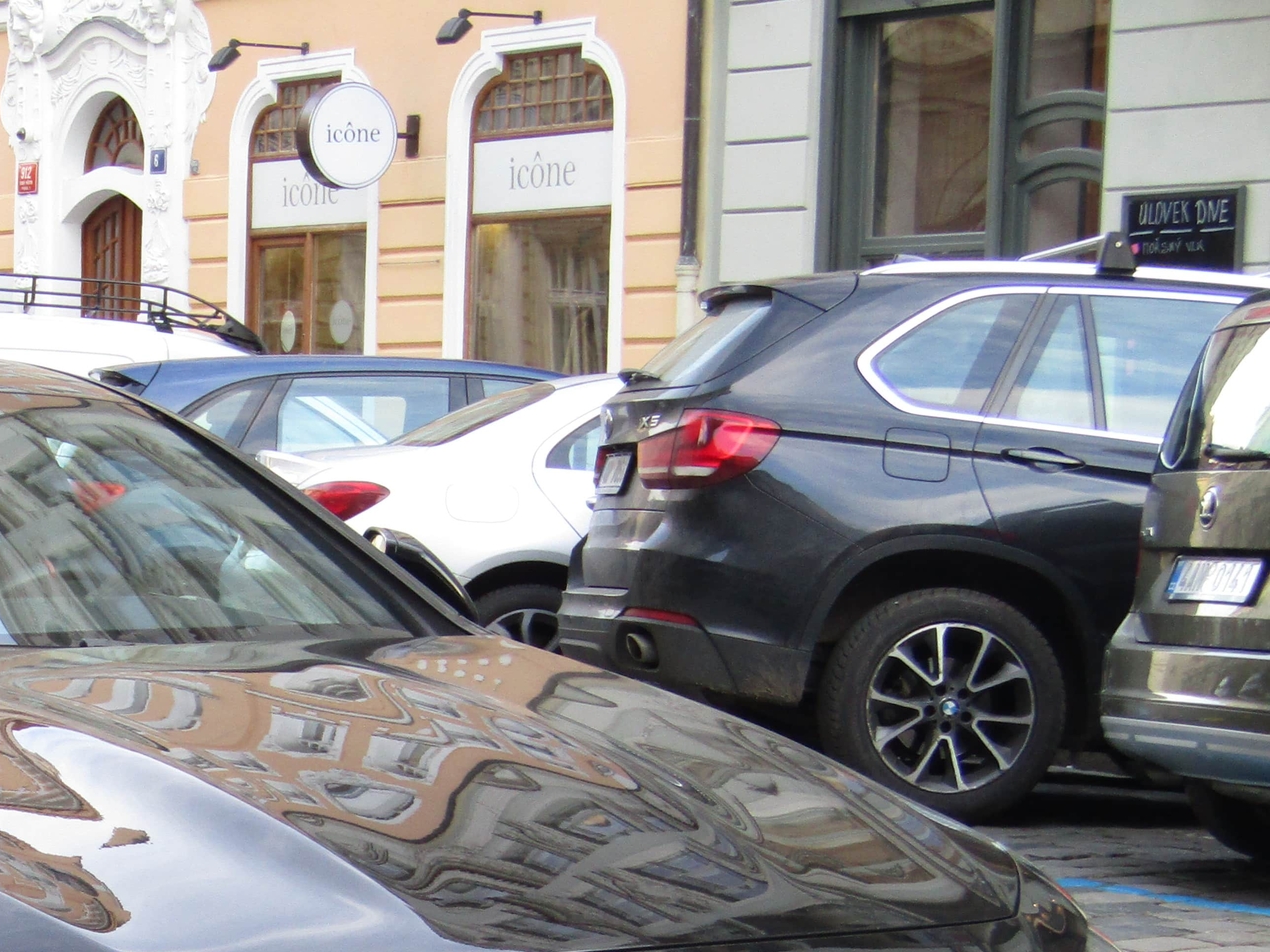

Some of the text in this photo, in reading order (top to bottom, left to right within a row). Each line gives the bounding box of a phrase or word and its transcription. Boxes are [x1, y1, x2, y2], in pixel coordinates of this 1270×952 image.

[325, 121, 381, 144] icône
[508, 151, 576, 191] icône
[1195, 199, 1229, 225] DNE
[640, 414, 661, 428] X5
